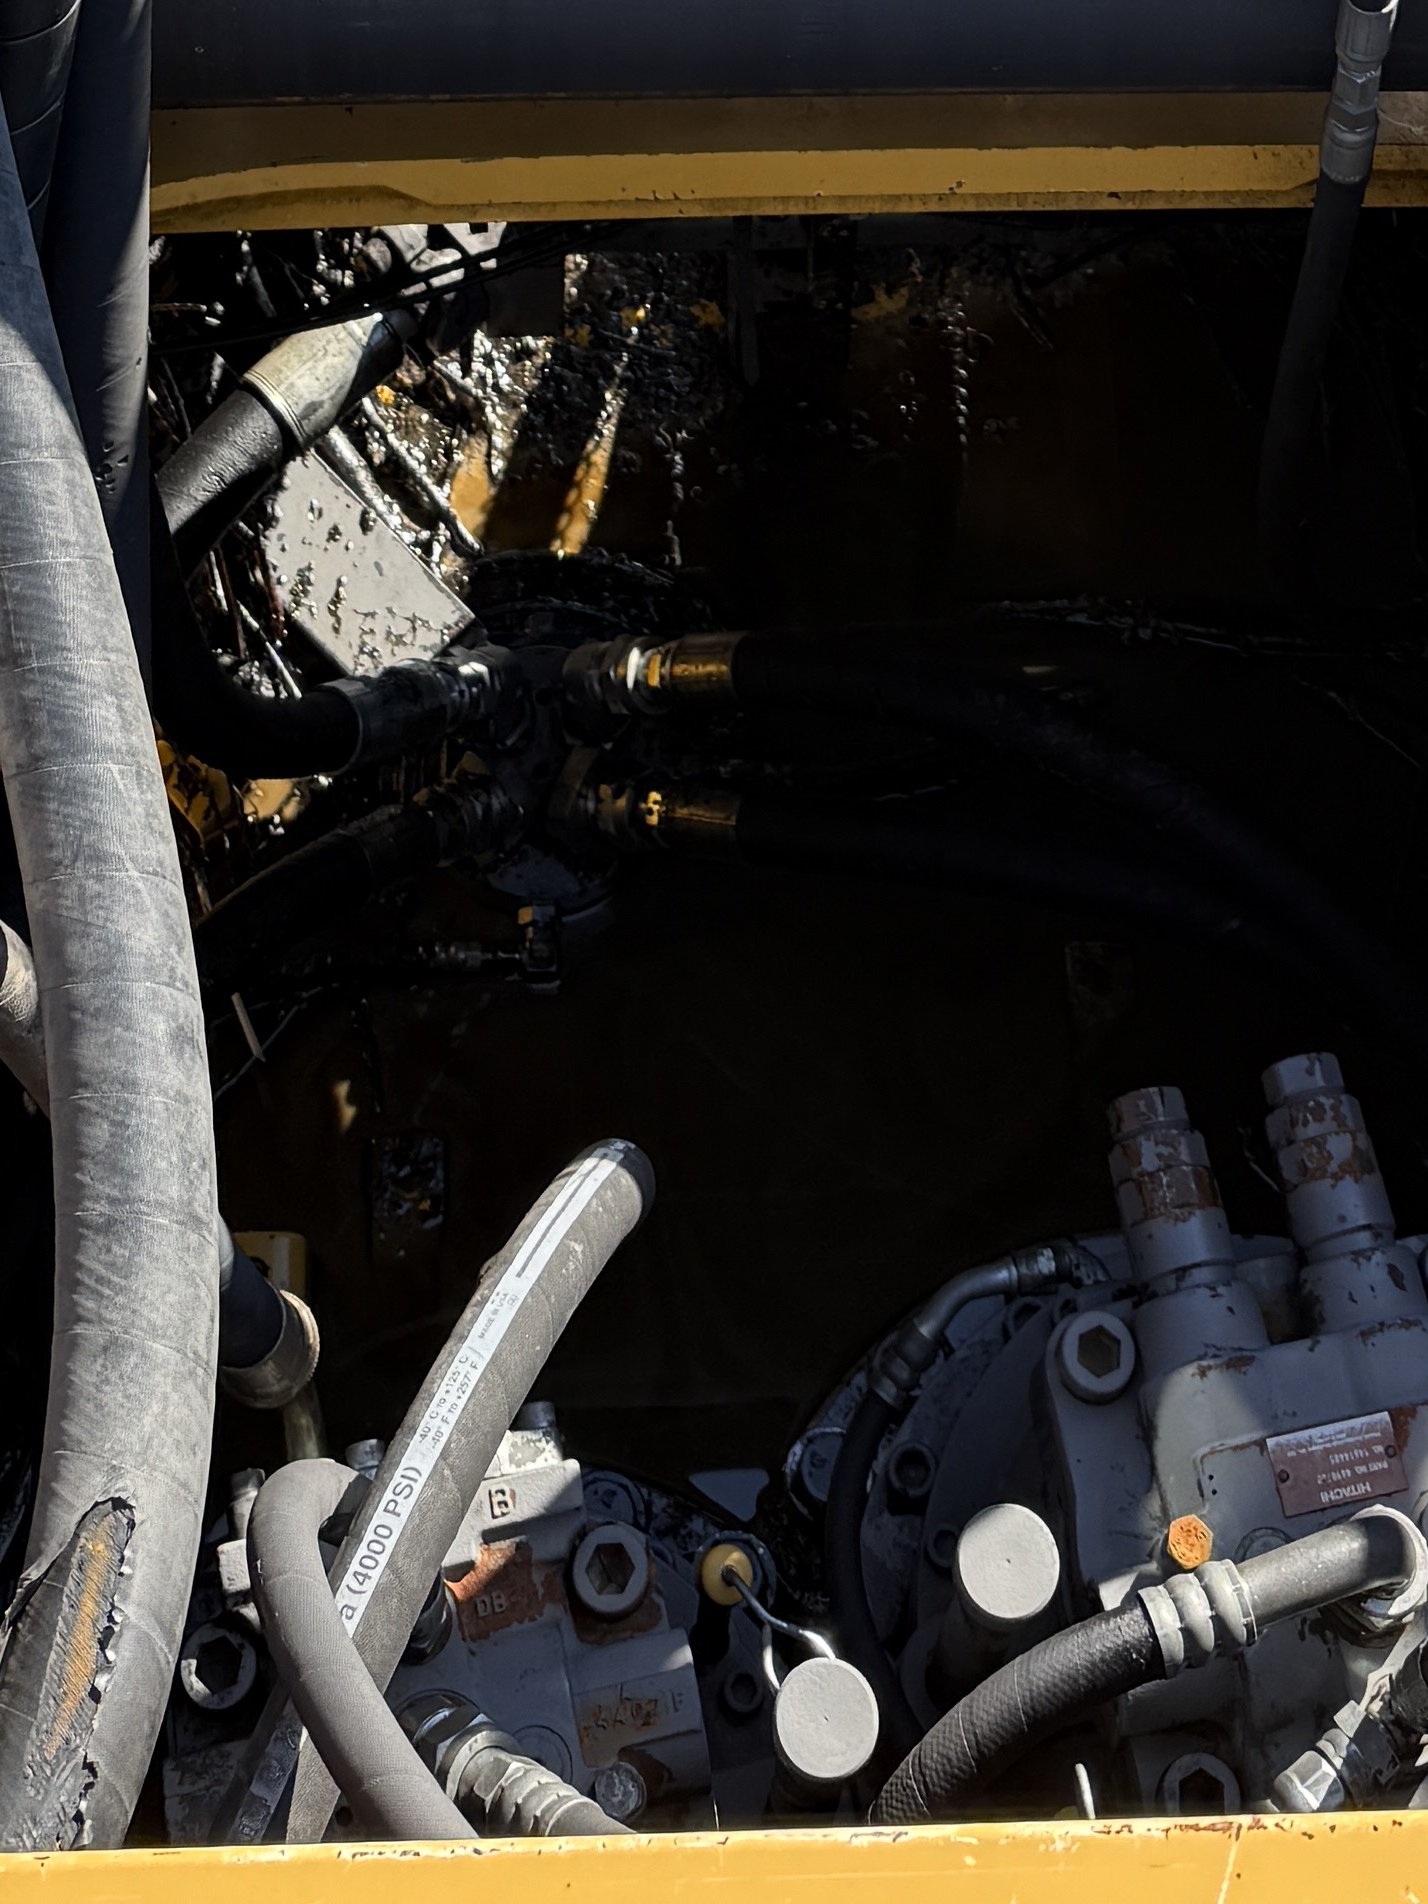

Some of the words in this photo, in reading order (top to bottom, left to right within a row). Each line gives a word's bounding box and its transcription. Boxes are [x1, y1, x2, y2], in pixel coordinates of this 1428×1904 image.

[343, 1519, 396, 1600] (4000
[382, 1461, 425, 1521] PSI)
[1319, 1481, 1371, 1503] HITACHI
